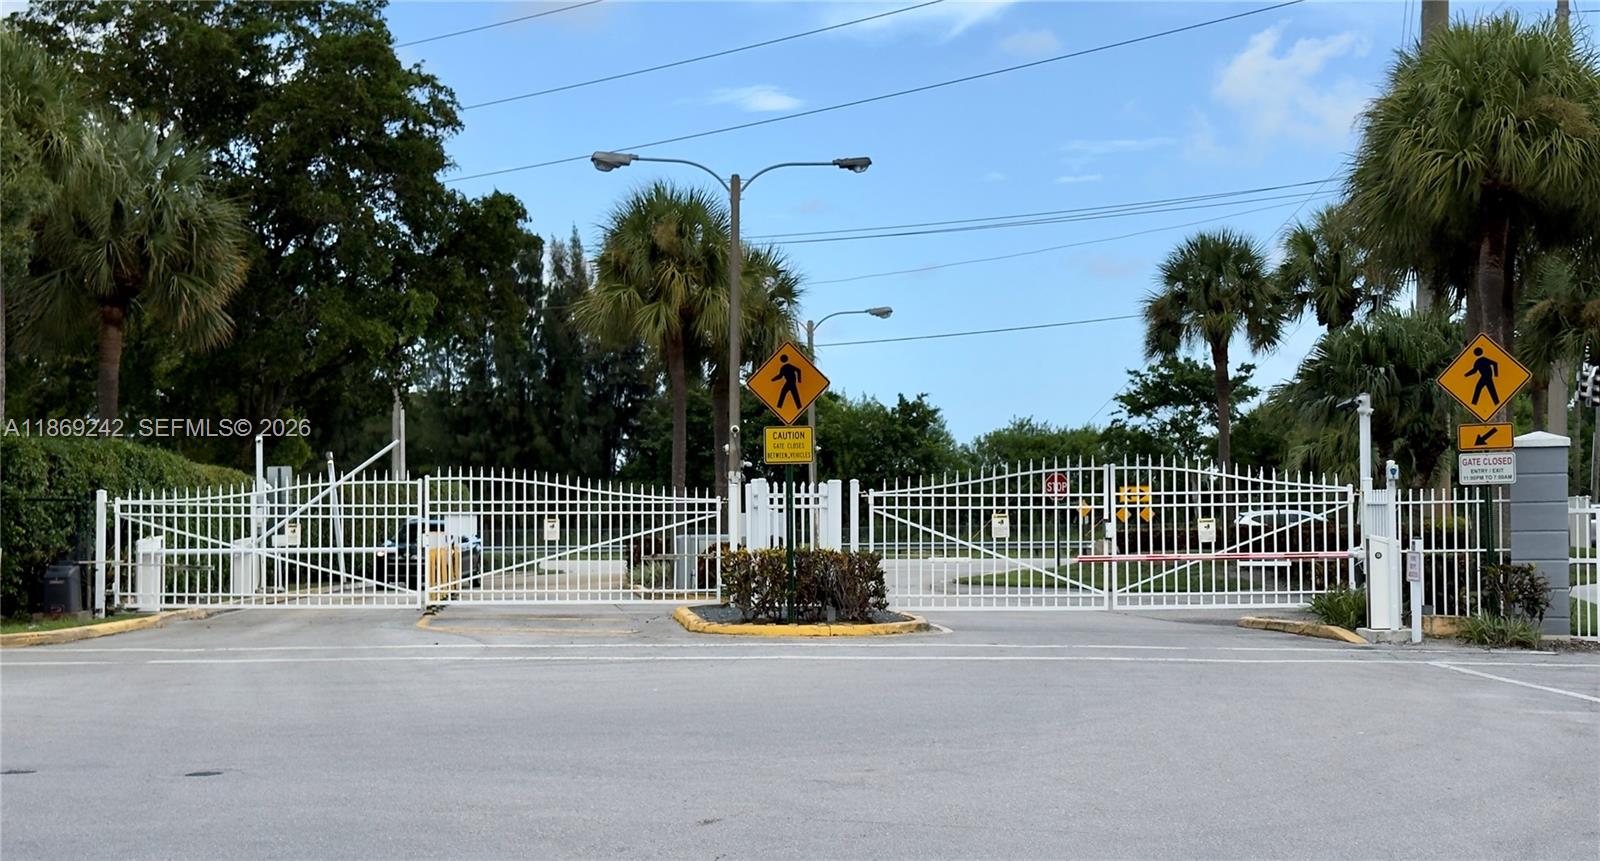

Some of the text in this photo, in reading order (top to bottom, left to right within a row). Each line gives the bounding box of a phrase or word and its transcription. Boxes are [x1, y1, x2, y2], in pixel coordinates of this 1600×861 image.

[772, 431, 805, 440] CAUTION
[1462, 457, 1513, 466] GATE CLOSED
[1046, 481, 1067, 493] STOP
